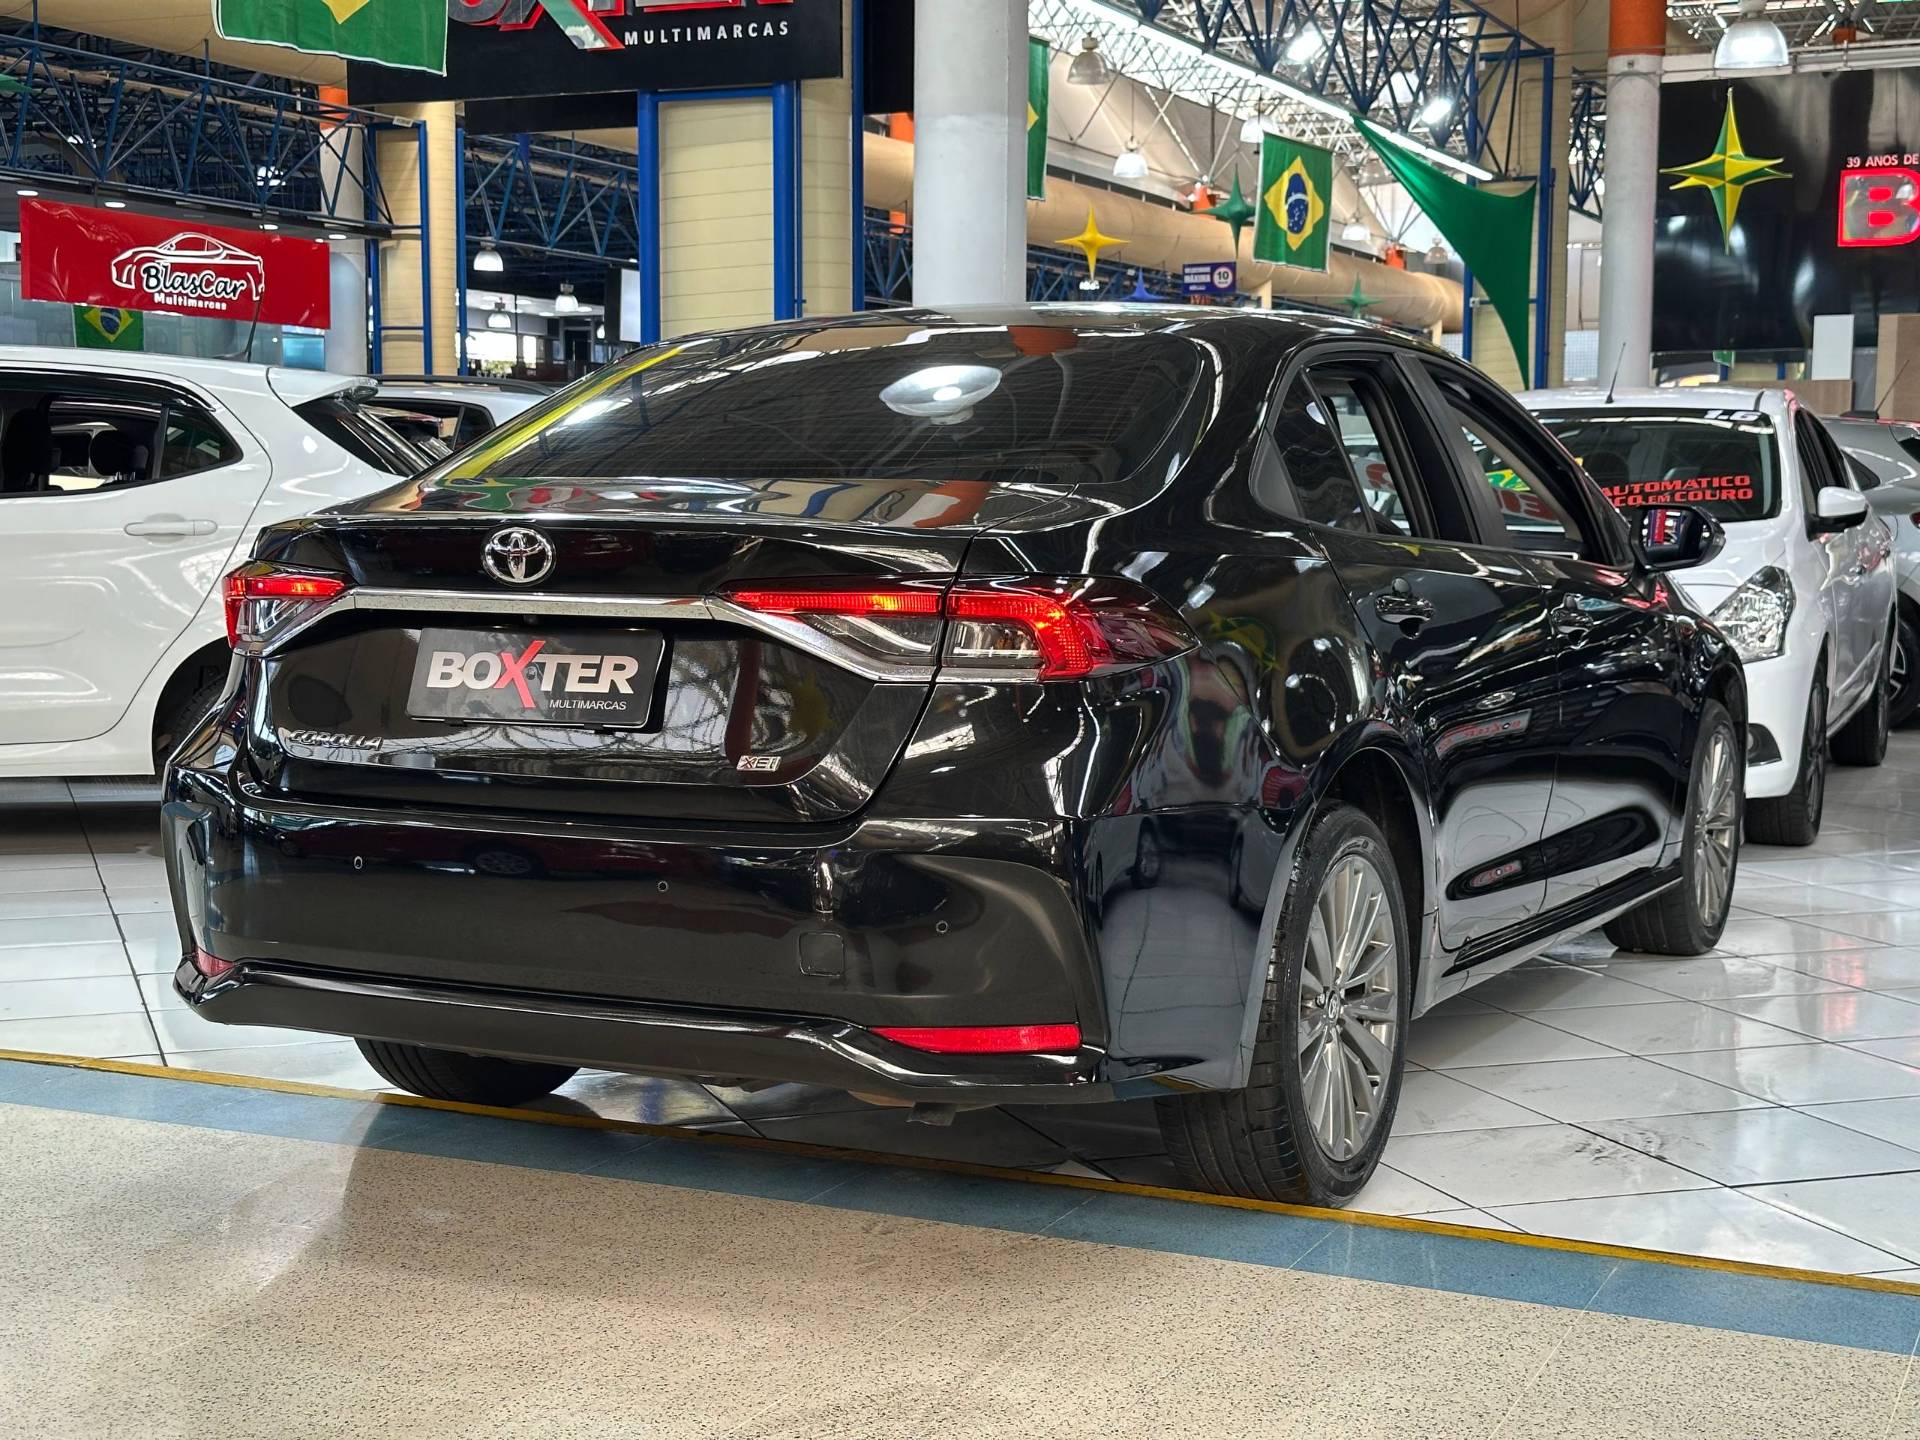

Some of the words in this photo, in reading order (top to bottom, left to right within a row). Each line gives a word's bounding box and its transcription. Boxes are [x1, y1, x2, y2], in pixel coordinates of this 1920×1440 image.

[624, 20, 790, 46] MULTIMARCAS
[1846, 156, 1861, 168] 39
[1865, 154, 1899, 167] ANOS
[1903, 153, 1920, 165] DE
[141, 262, 246, 300] BlasCar
[1216, 271, 1230, 281] 10
[154, 293, 227, 310] Multimarcas
[1703, 409, 1762, 422] 1.6
[1648, 494, 1671, 504] EM
[1674, 487, 1754, 503] COURO
[426, 640, 639, 709] BOXTER
[549, 699, 627, 711] MULTIMARCAS
[289, 729, 384, 751] COROLLA
